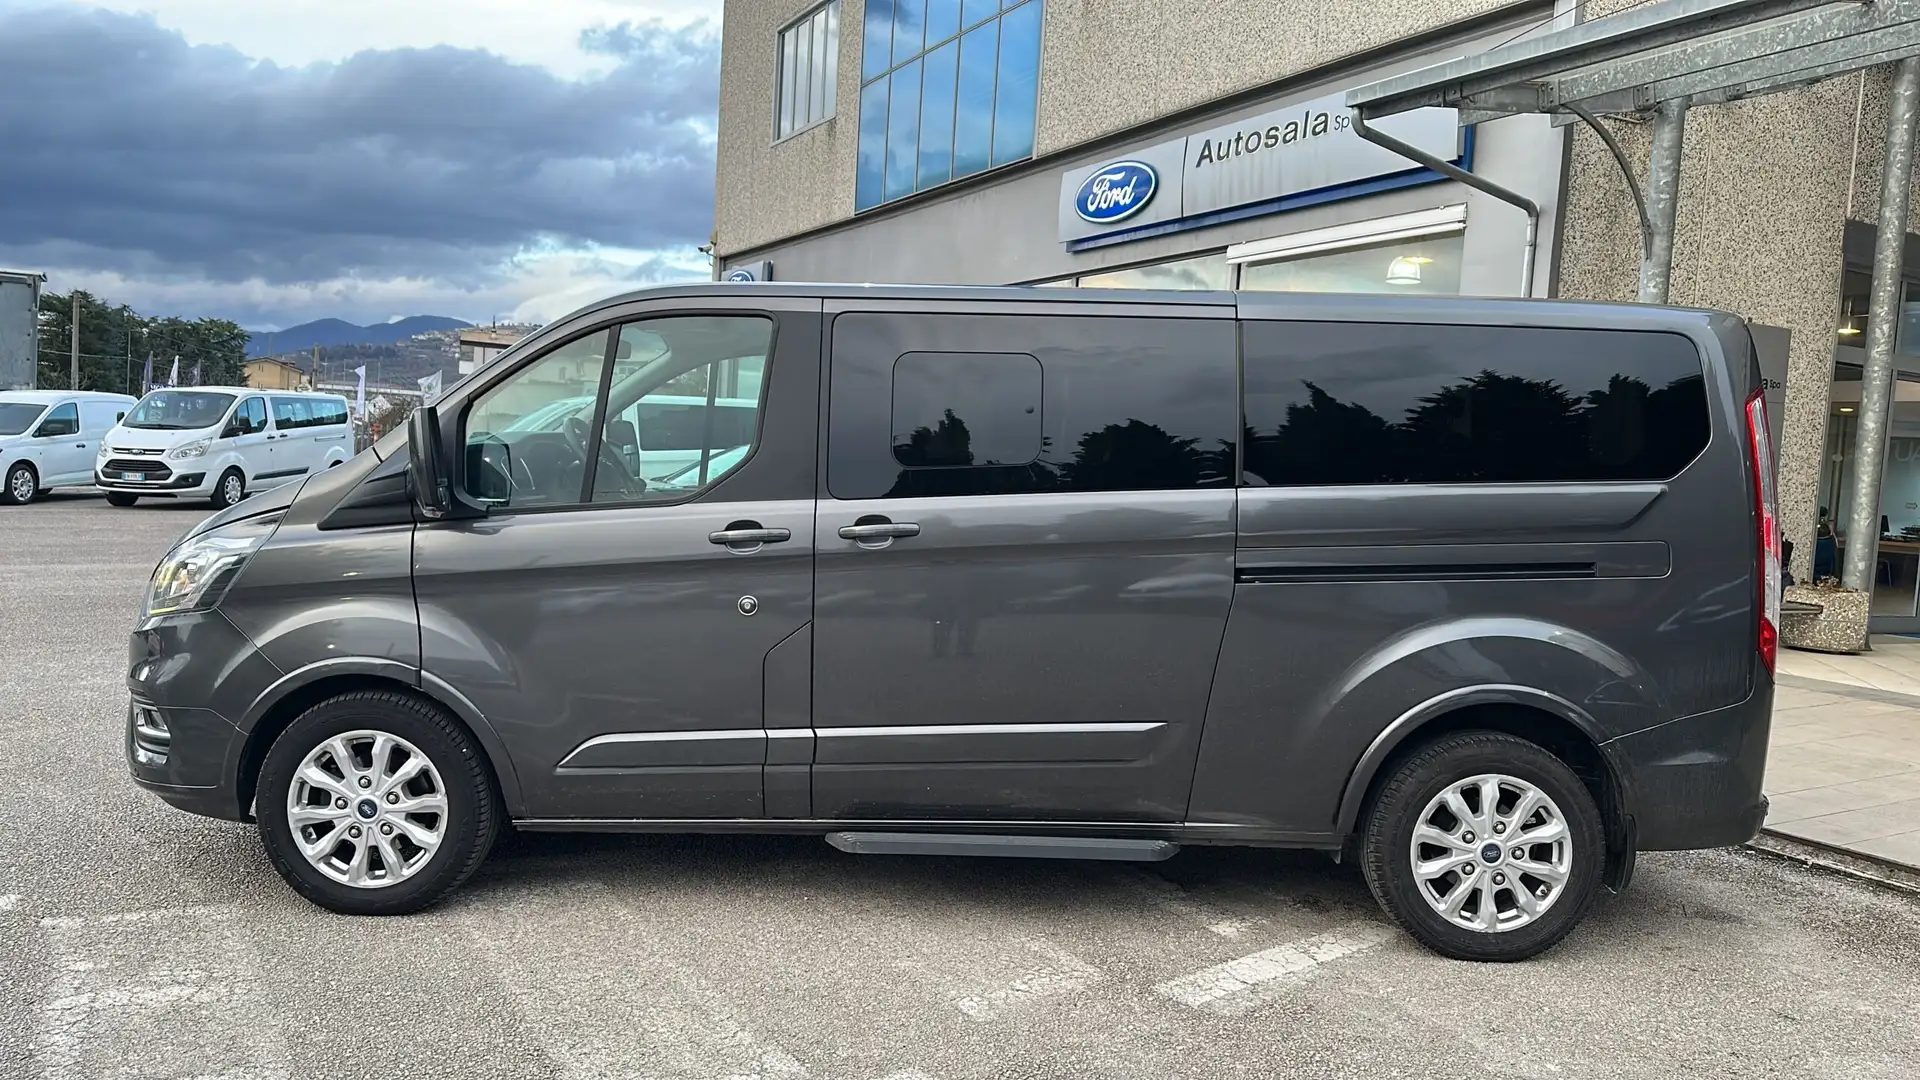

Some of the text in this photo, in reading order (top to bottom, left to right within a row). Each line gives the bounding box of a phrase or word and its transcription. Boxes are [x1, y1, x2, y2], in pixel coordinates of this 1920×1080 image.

[1195, 110, 1350, 168] Autosala Sp
[1087, 171, 1138, 212] Ford
